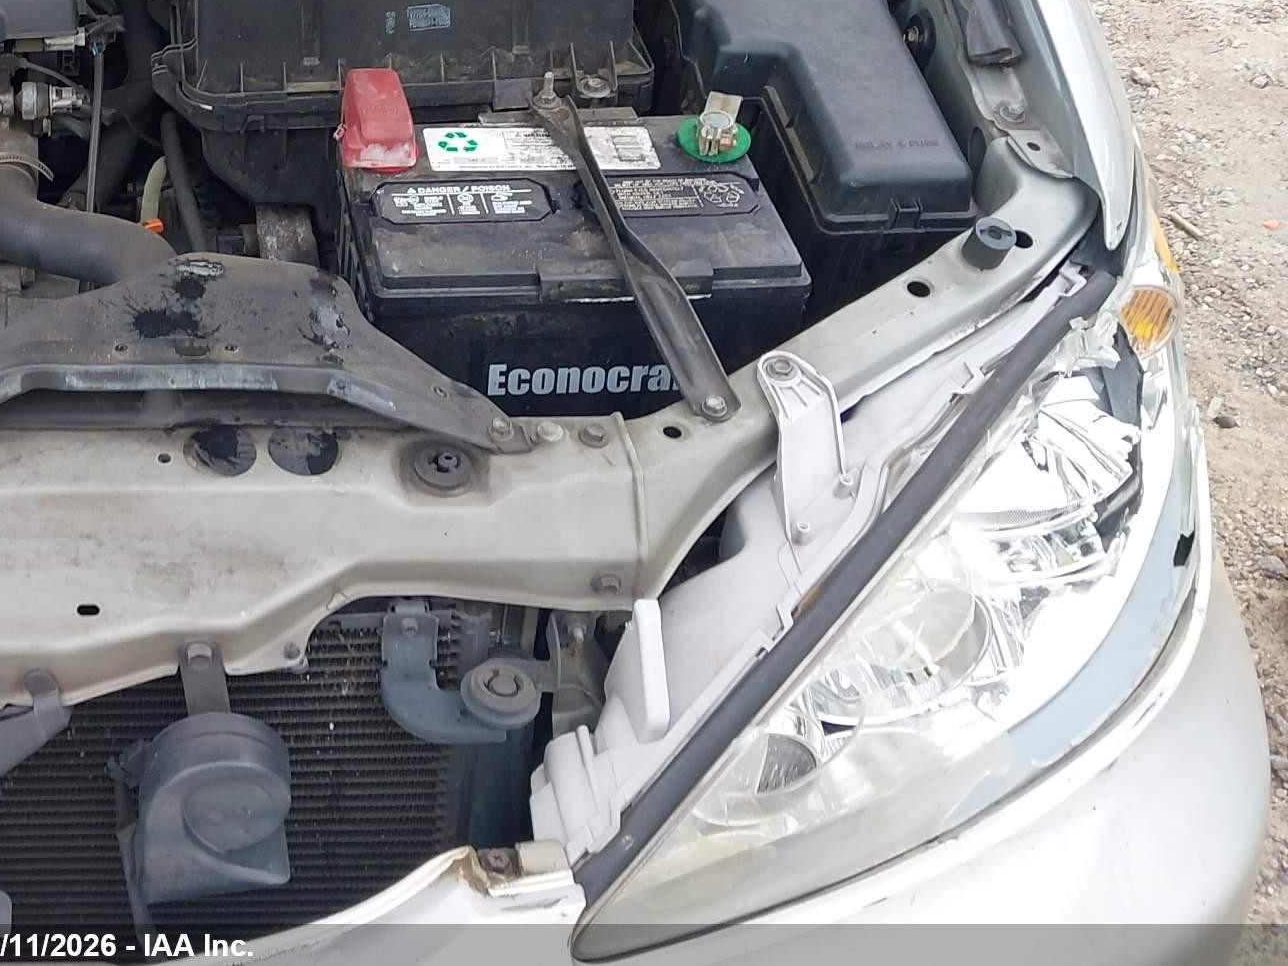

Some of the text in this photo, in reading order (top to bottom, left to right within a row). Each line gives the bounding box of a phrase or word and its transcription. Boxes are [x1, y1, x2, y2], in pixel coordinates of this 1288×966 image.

[417, 185, 461, 194] DANGER
[470, 184, 511, 193] POISON
[487, 363, 680, 396] Econocra
